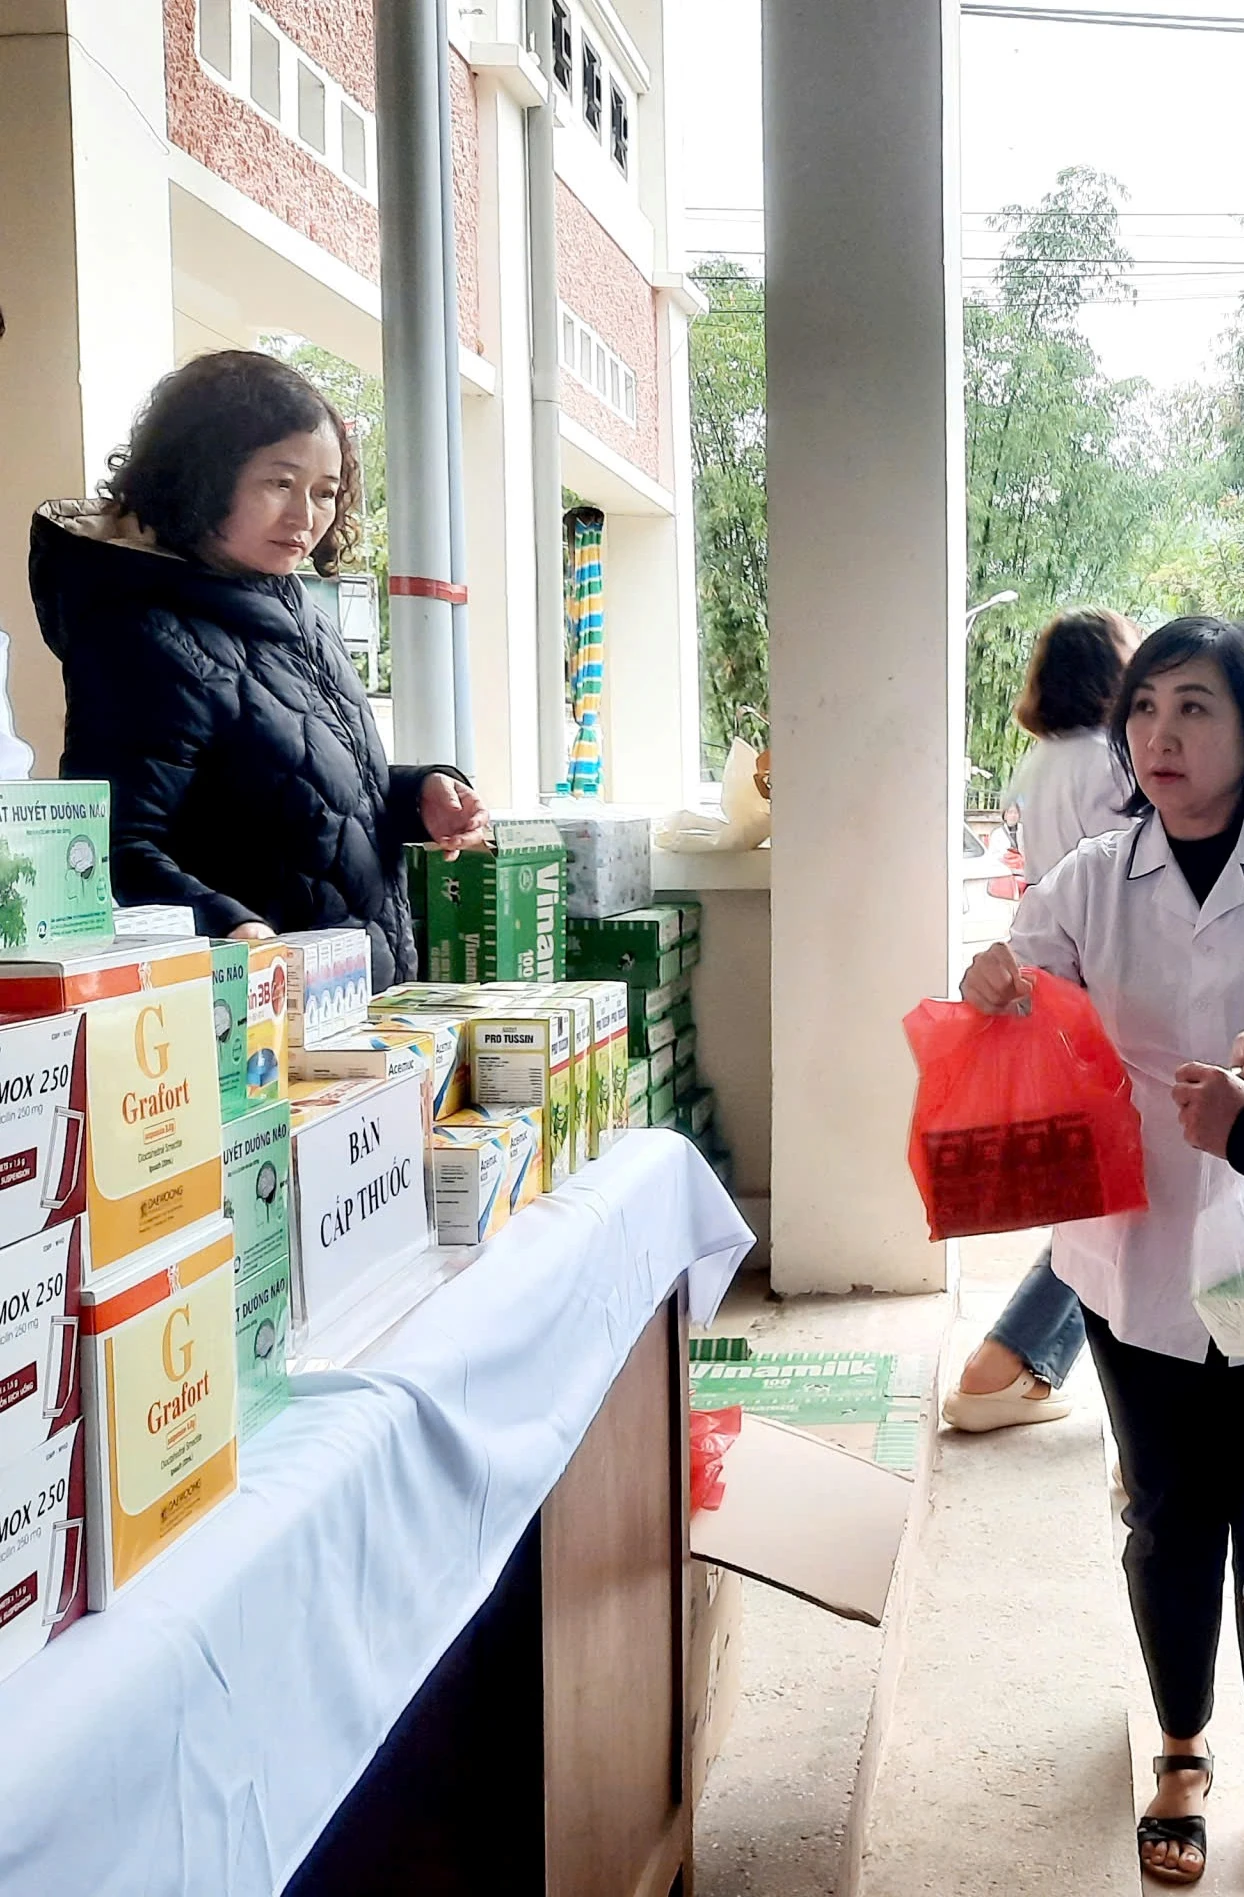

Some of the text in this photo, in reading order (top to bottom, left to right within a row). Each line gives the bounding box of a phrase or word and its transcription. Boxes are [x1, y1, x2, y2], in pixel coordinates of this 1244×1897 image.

[522, 949, 535, 977] 100
[258, 982, 270, 1007] 3B
[135, 1004, 171, 1080] G
[484, 1034, 534, 1044] PRO TUSSIN
[40, 1064, 69, 1094] 250
[388, 1059, 415, 1077] Acemuc
[122, 1077, 190, 1125] Grafort
[349, 1116, 380, 1165] BÀN
[320, 1194, 354, 1248] CẤP
[357, 1155, 411, 1221] THUỐC
[36, 1273, 64, 1308] 250
[27, 1317, 39, 1330] mg
[162, 1303, 195, 1382] G
[689, 1360, 877, 1379] Vinamilk
[147, 1369, 210, 1435] Grafort
[37, 1478, 66, 1519] 250
[30, 1526, 42, 1542] mg
